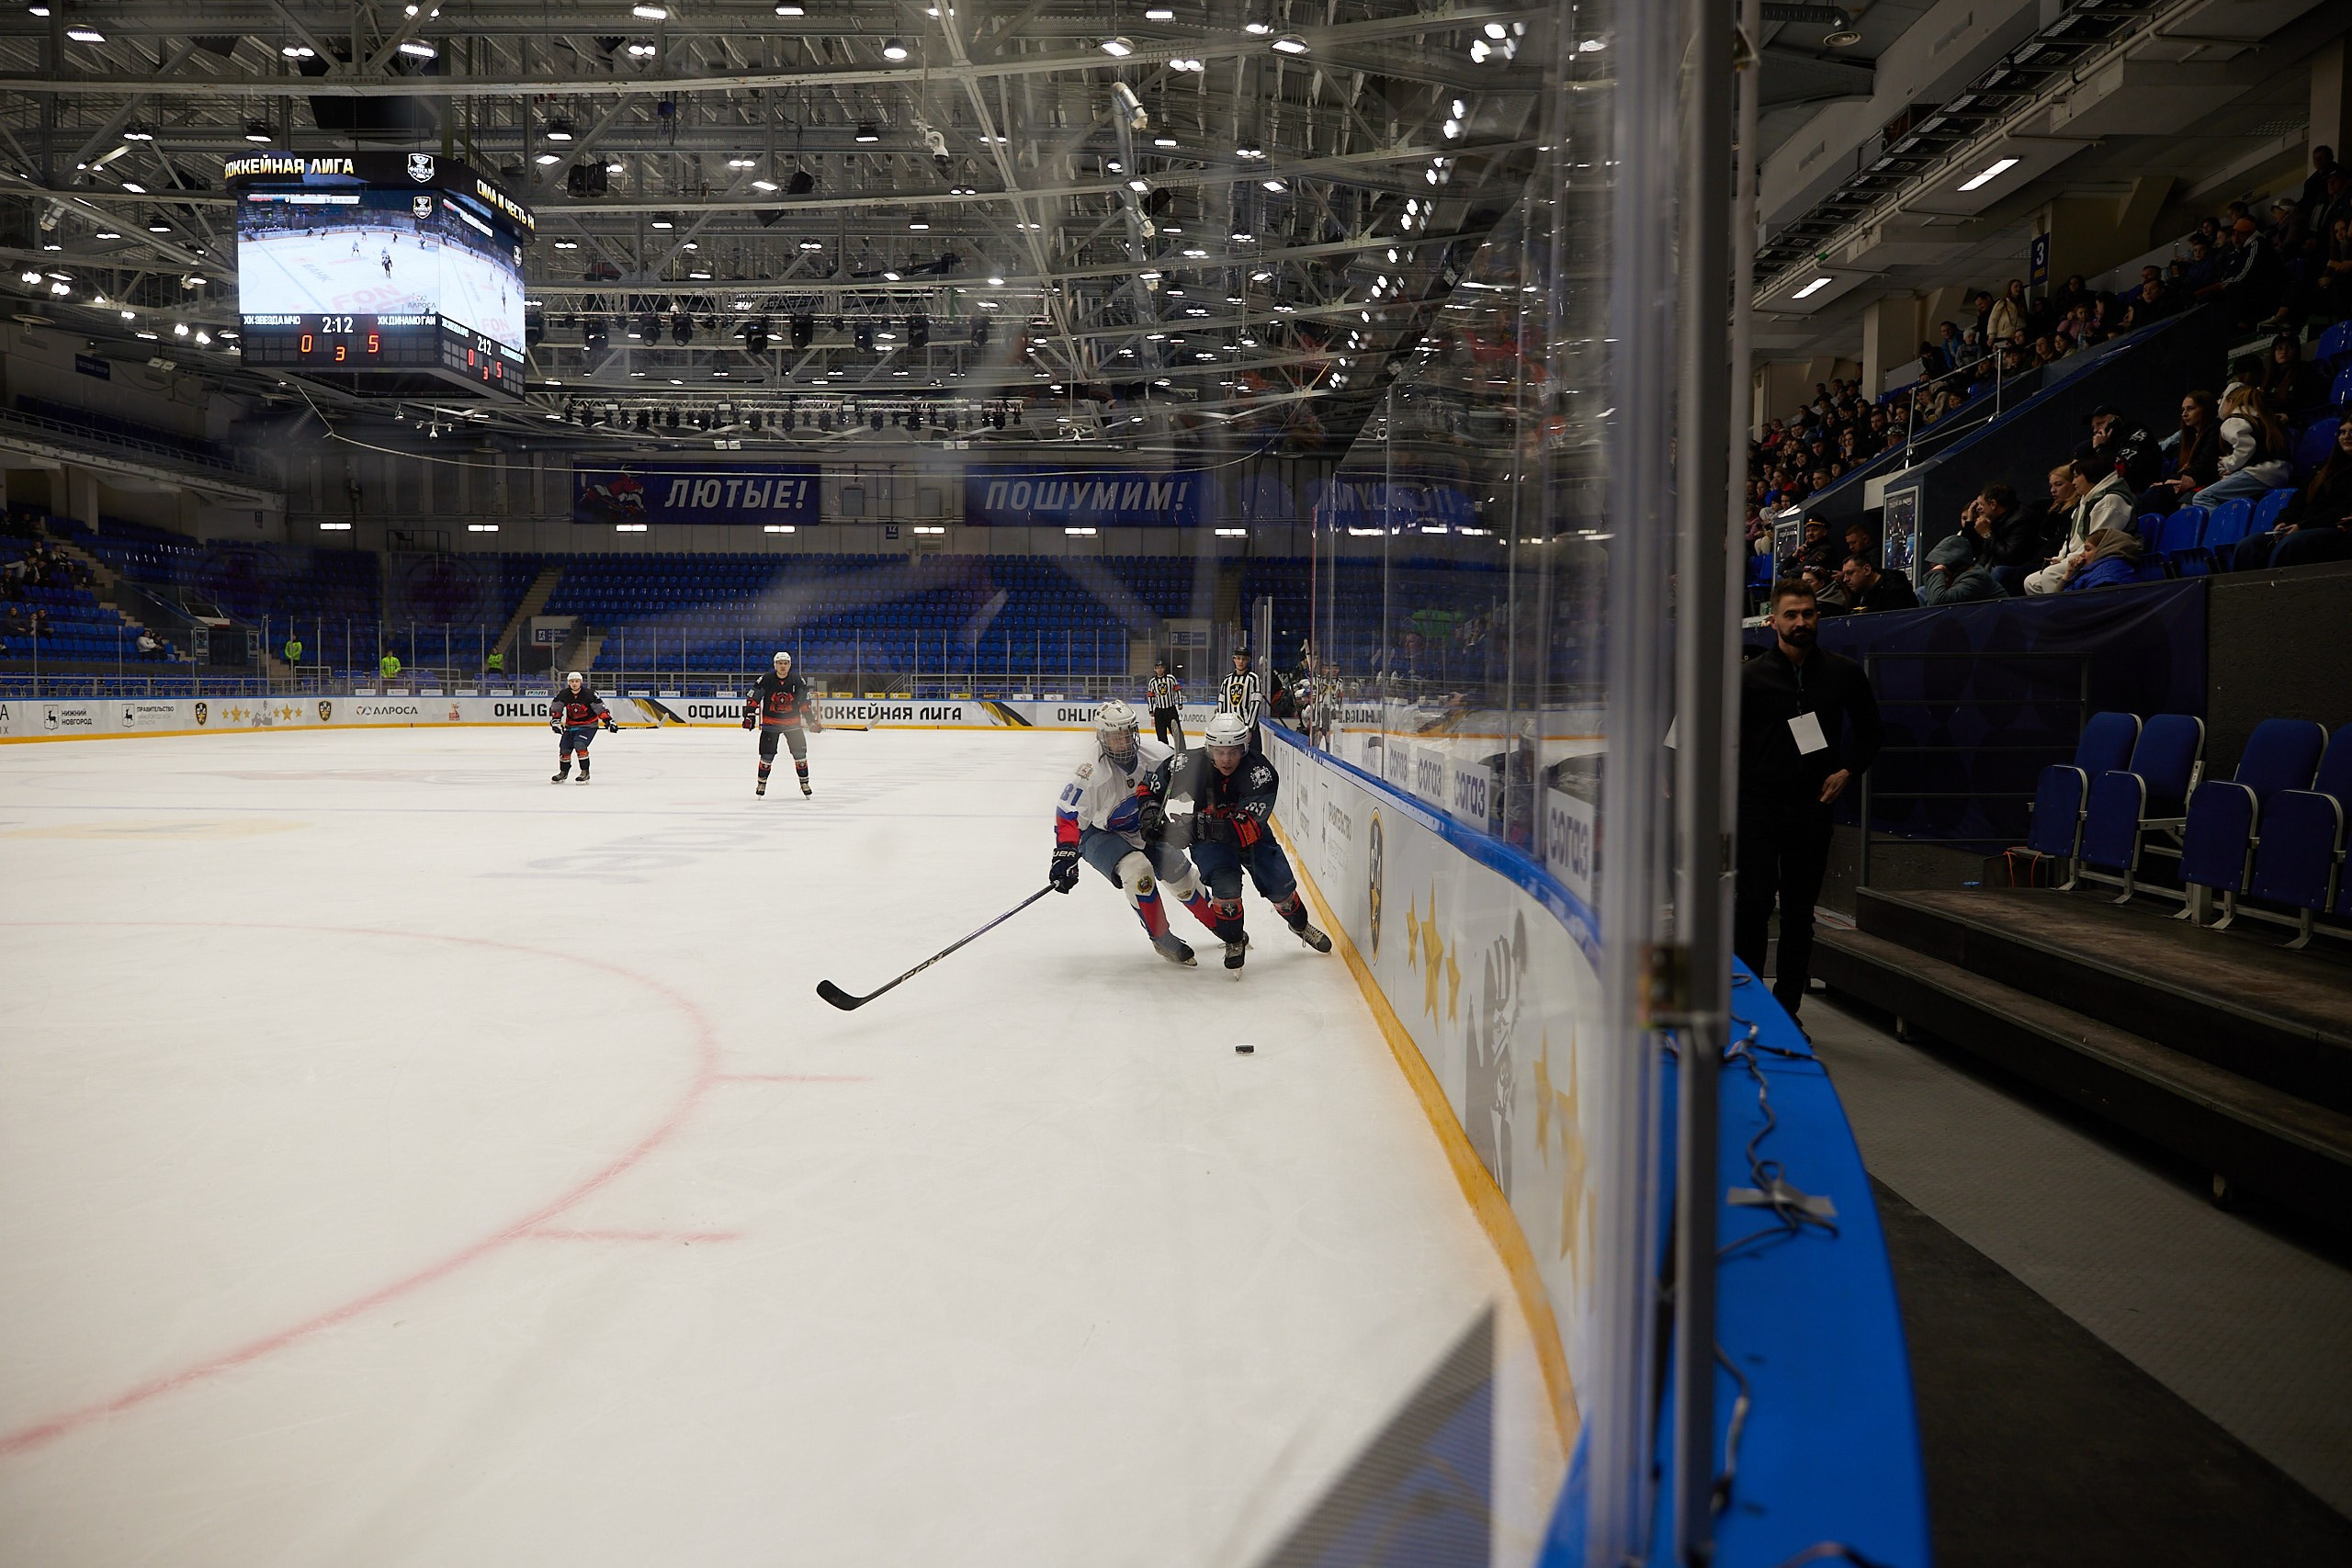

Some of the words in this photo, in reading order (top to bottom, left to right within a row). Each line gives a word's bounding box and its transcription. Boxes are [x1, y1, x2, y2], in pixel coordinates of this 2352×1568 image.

[310, 158, 354, 175] ЛИГА
[477, 178, 497, 206] СИЛА
[497, 193, 504, 209] И
[504, 197, 527, 225] ЧЕСТЬ
[2036, 242, 2044, 265] 3
[322, 316, 354, 333] 2:12
[300, 334, 312, 353] 0
[368, 334, 379, 354] 5
[334, 345, 345, 361] 3
[468, 348, 474, 366] 0
[482, 366, 489, 380] 3
[496, 361, 503, 378] 5
[664, 478, 808, 510] ЛЮТЫЕ!
[984, 480, 1189, 512] ПОШУМИМ!
[62, 708, 86, 716] НИЖНИЙ
[494, 703, 553, 716] OHLIG
[688, 705, 746, 719] ОФИЦ
[920, 706, 962, 720] ЛИГА
[1059, 783, 1084, 807] 81
[1453, 770, 1486, 818] согаз
[1052, 851, 1077, 859] UER
